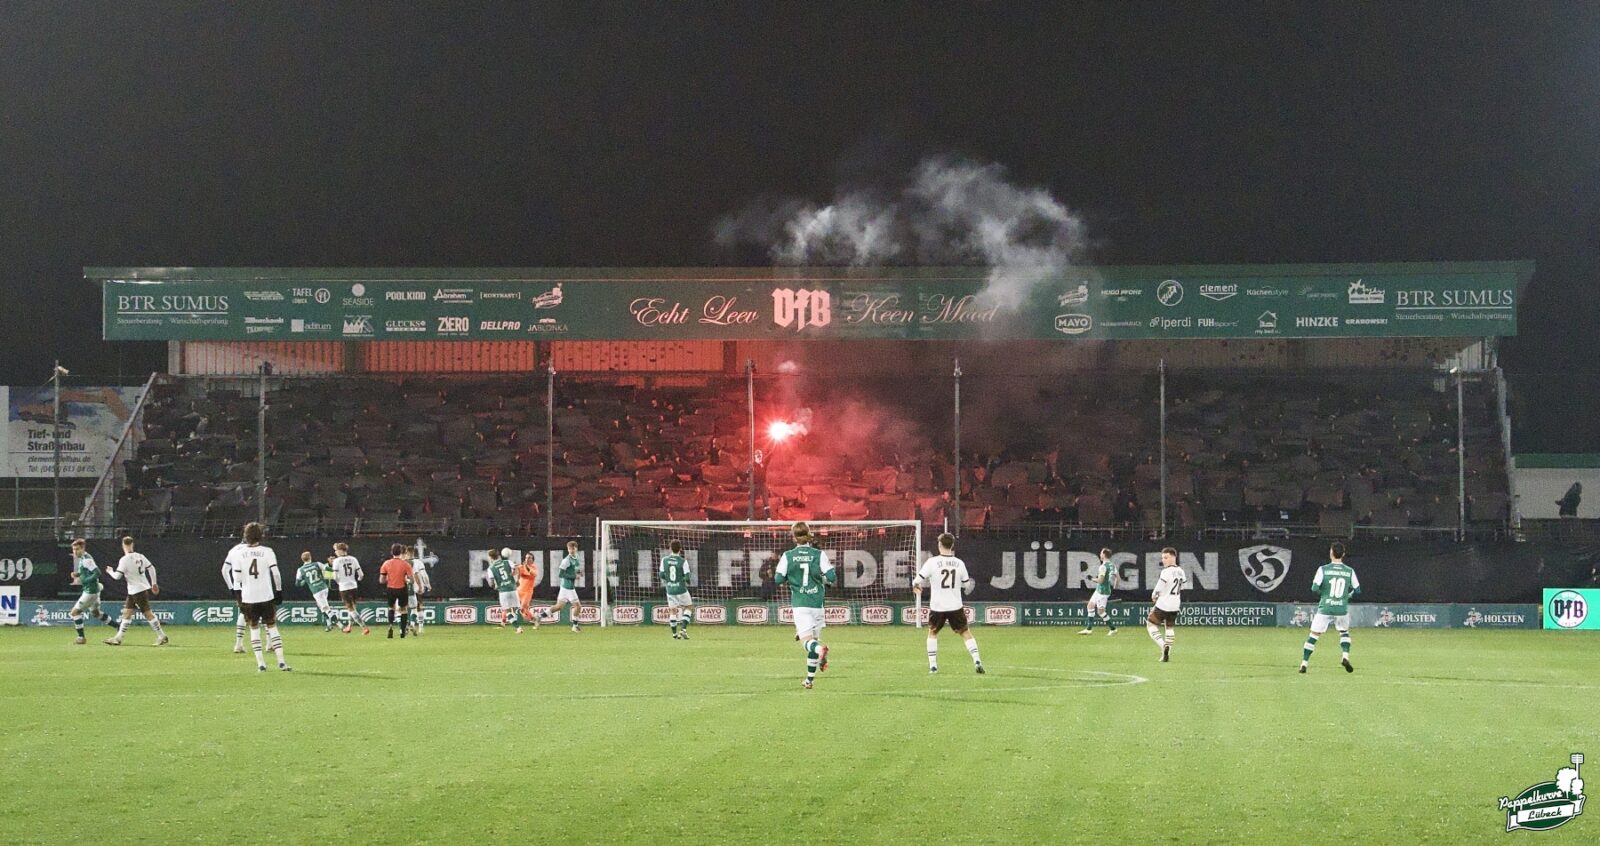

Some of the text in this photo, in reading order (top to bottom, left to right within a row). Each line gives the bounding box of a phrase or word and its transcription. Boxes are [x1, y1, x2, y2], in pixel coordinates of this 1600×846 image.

[292, 288, 313, 297] TAFEL
[1200, 284, 1238, 292] clement
[118, 295, 156, 310] BTR
[162, 295, 229, 311] SUMUS
[342, 297, 375, 306] SEASIDE
[1396, 290, 1436, 306] BTR
[1442, 290, 1513, 306] SUMUS
[630, 295, 759, 327] Echt Leev
[847, 293, 1000, 324] Keen Mood
[480, 321, 521, 330] DELLPRO
[1058, 318, 1088, 327] MAYO
[1160, 316, 1192, 330] iperdi
[1296, 316, 1339, 327] HINZKE
[528, 324, 569, 332] JABLONKA
[27, 428, 51, 439] Tief-
[27, 441, 85, 451] Straßnbau
[249, 558, 259, 579] 4
[343, 562, 353, 577] 15
[990, 541, 1219, 591] JÜRGEN
[498, 567, 508, 581] 5
[669, 565, 677, 582] 8
[800, 563, 810, 587] 7
[940, 568, 957, 589] 21
[1328, 577, 1346, 599] 10
[207, 606, 234, 617] FLS
[291, 607, 318, 617] FLS
[1024, 608, 1130, 617] KENSINON
[1178, 607, 1274, 616] MOBILIENEXPERTEN
[1175, 615, 1224, 625] LÜBECKER
[1227, 616, 1262, 625] BUCHT.
[1396, 614, 1437, 622] HOLSTEN
[1484, 614, 1524, 623] HOLSTEN
